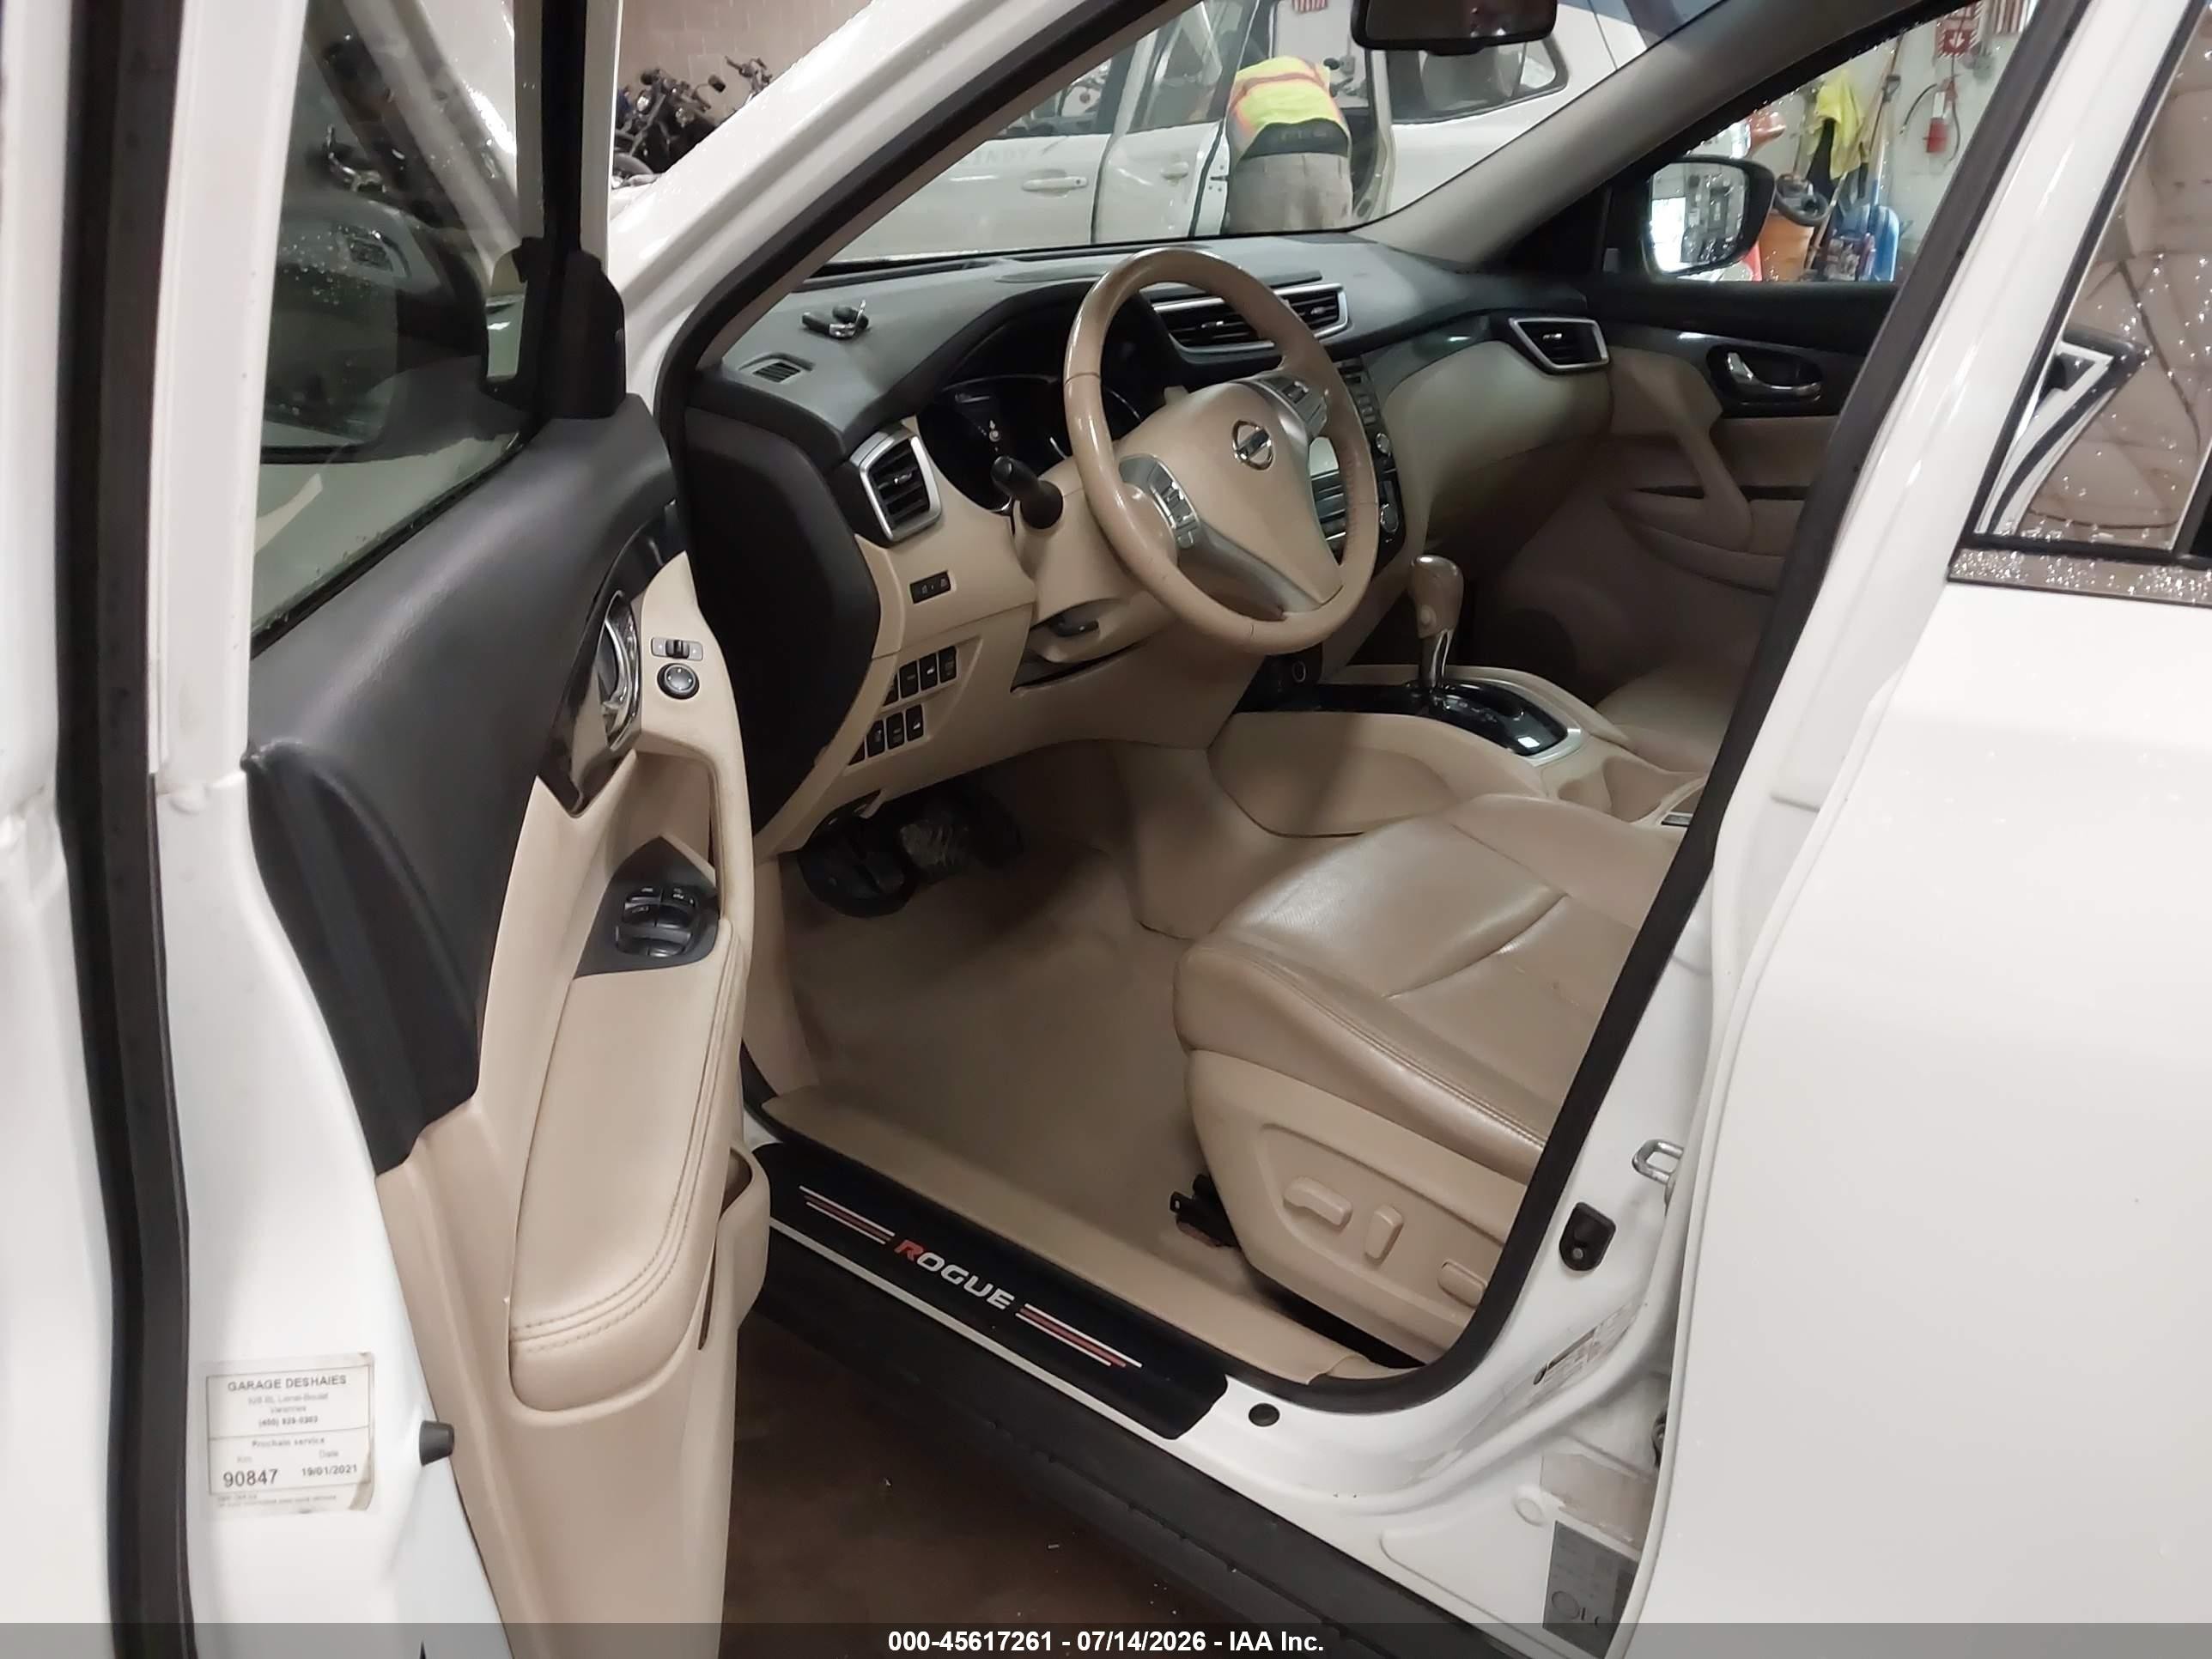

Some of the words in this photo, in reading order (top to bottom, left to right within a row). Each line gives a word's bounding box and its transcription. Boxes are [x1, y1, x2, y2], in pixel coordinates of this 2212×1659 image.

[894, 1239, 1015, 1310] ROGUE
[228, 1377, 282, 1392] GARAGE
[285, 1375, 347, 1389] DESHAIES
[295, 1437, 325, 1446] service
[223, 1468, 278, 1487] 90847
[301, 1464, 357, 1476] 19/01/2021
